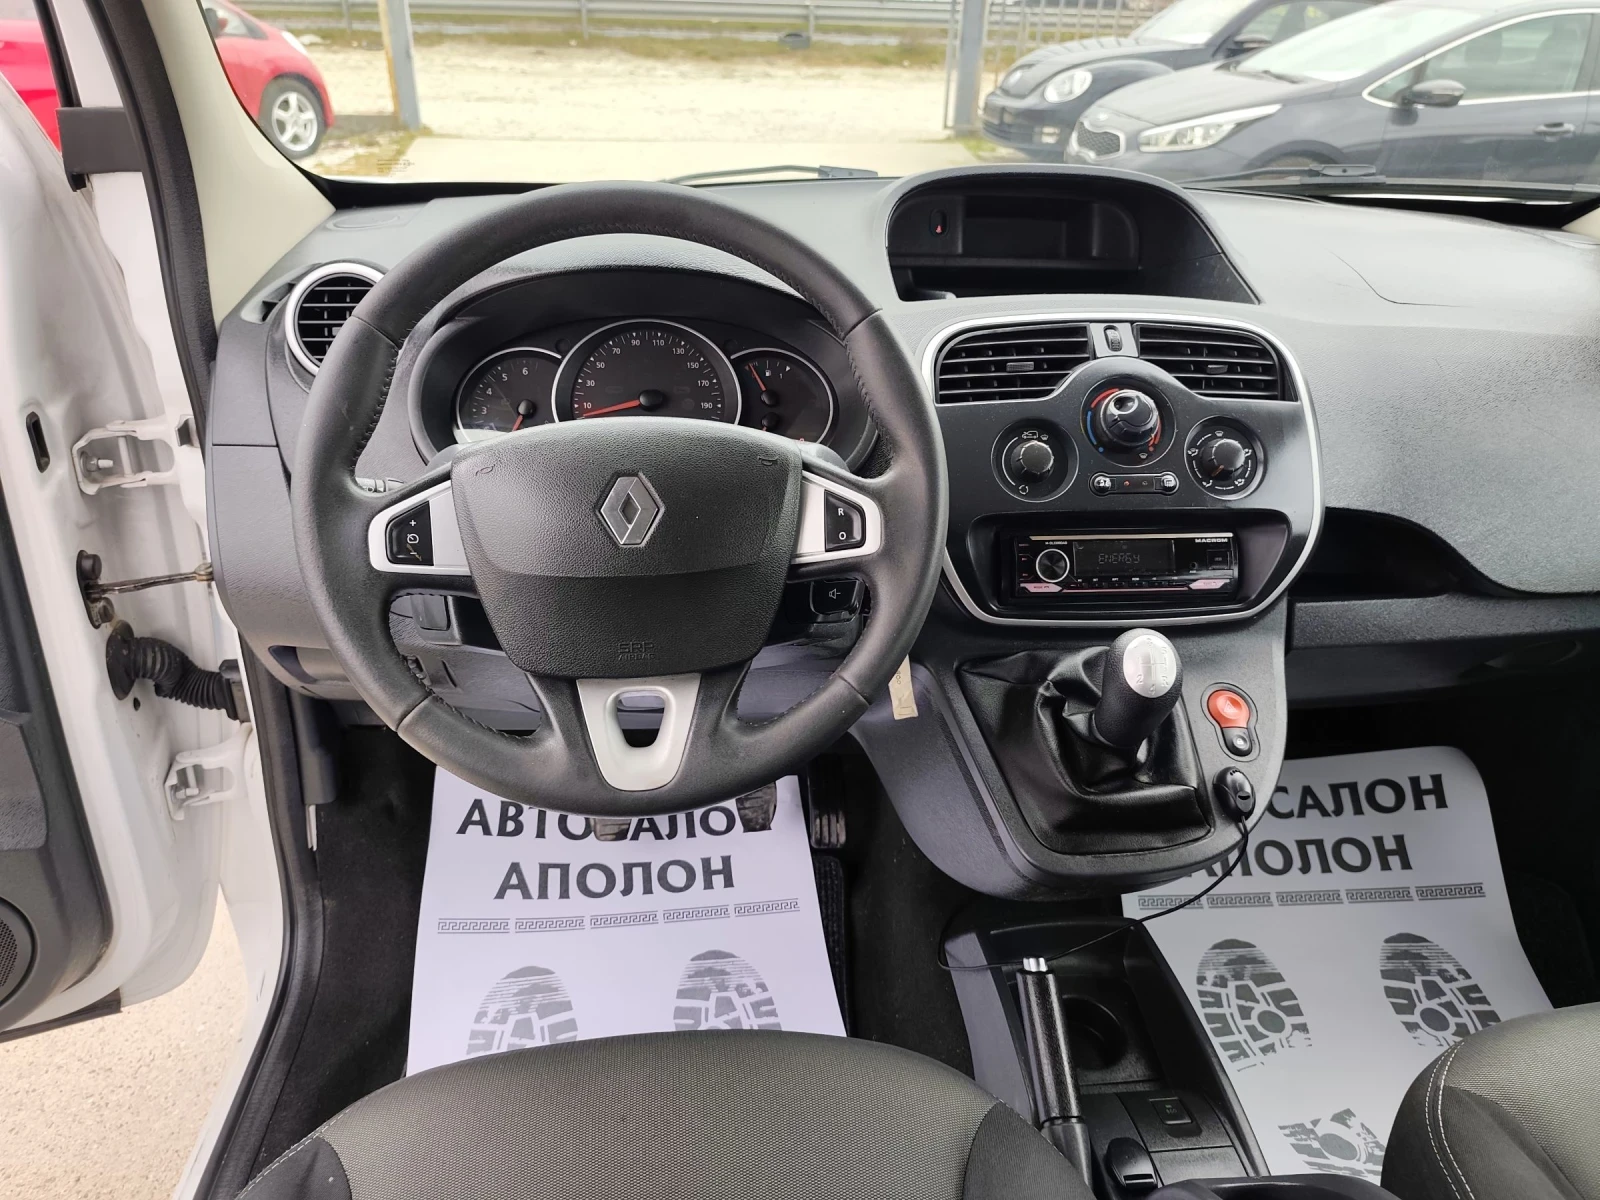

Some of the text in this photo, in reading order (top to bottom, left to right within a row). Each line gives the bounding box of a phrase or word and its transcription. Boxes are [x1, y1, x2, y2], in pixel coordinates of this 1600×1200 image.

[672, 347, 685, 355] 130
[596, 361, 605, 369] 50
[687, 361, 700, 369] 150
[522, 367, 529, 375] 6
[501, 373, 508, 381] 5
[586, 379, 596, 387] 30
[697, 379, 710, 387] 170
[486, 387, 493, 395] 4
[481, 406, 487, 414] 3
[838, 507, 845, 516] R
[1098, 552, 1140, 564] ENERGY
[1266, 773, 1449, 820] САЛОН
[456, 798, 772, 841] АВТОАЛО
[494, 855, 735, 900] АПОЛОН
